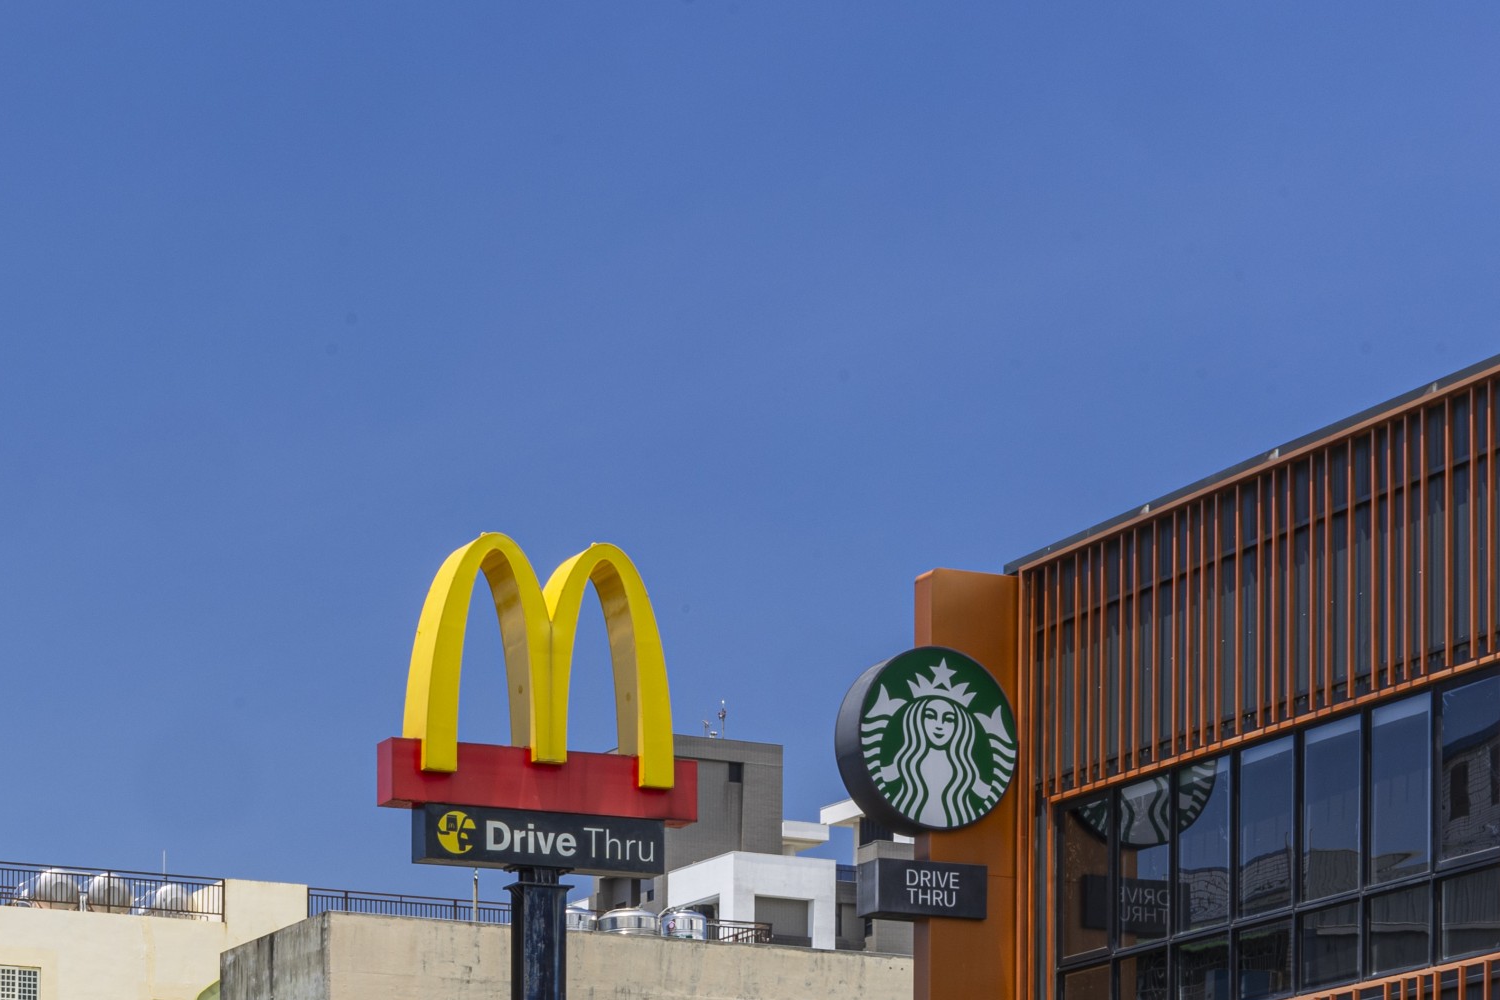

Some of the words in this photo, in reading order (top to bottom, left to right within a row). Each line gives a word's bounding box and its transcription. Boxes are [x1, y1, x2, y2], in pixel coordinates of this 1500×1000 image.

[485, 819, 577, 858] Drive
[583, 826, 655, 863] Thru
[906, 869, 960, 890] DRIVE
[907, 887, 957, 908] THRU
